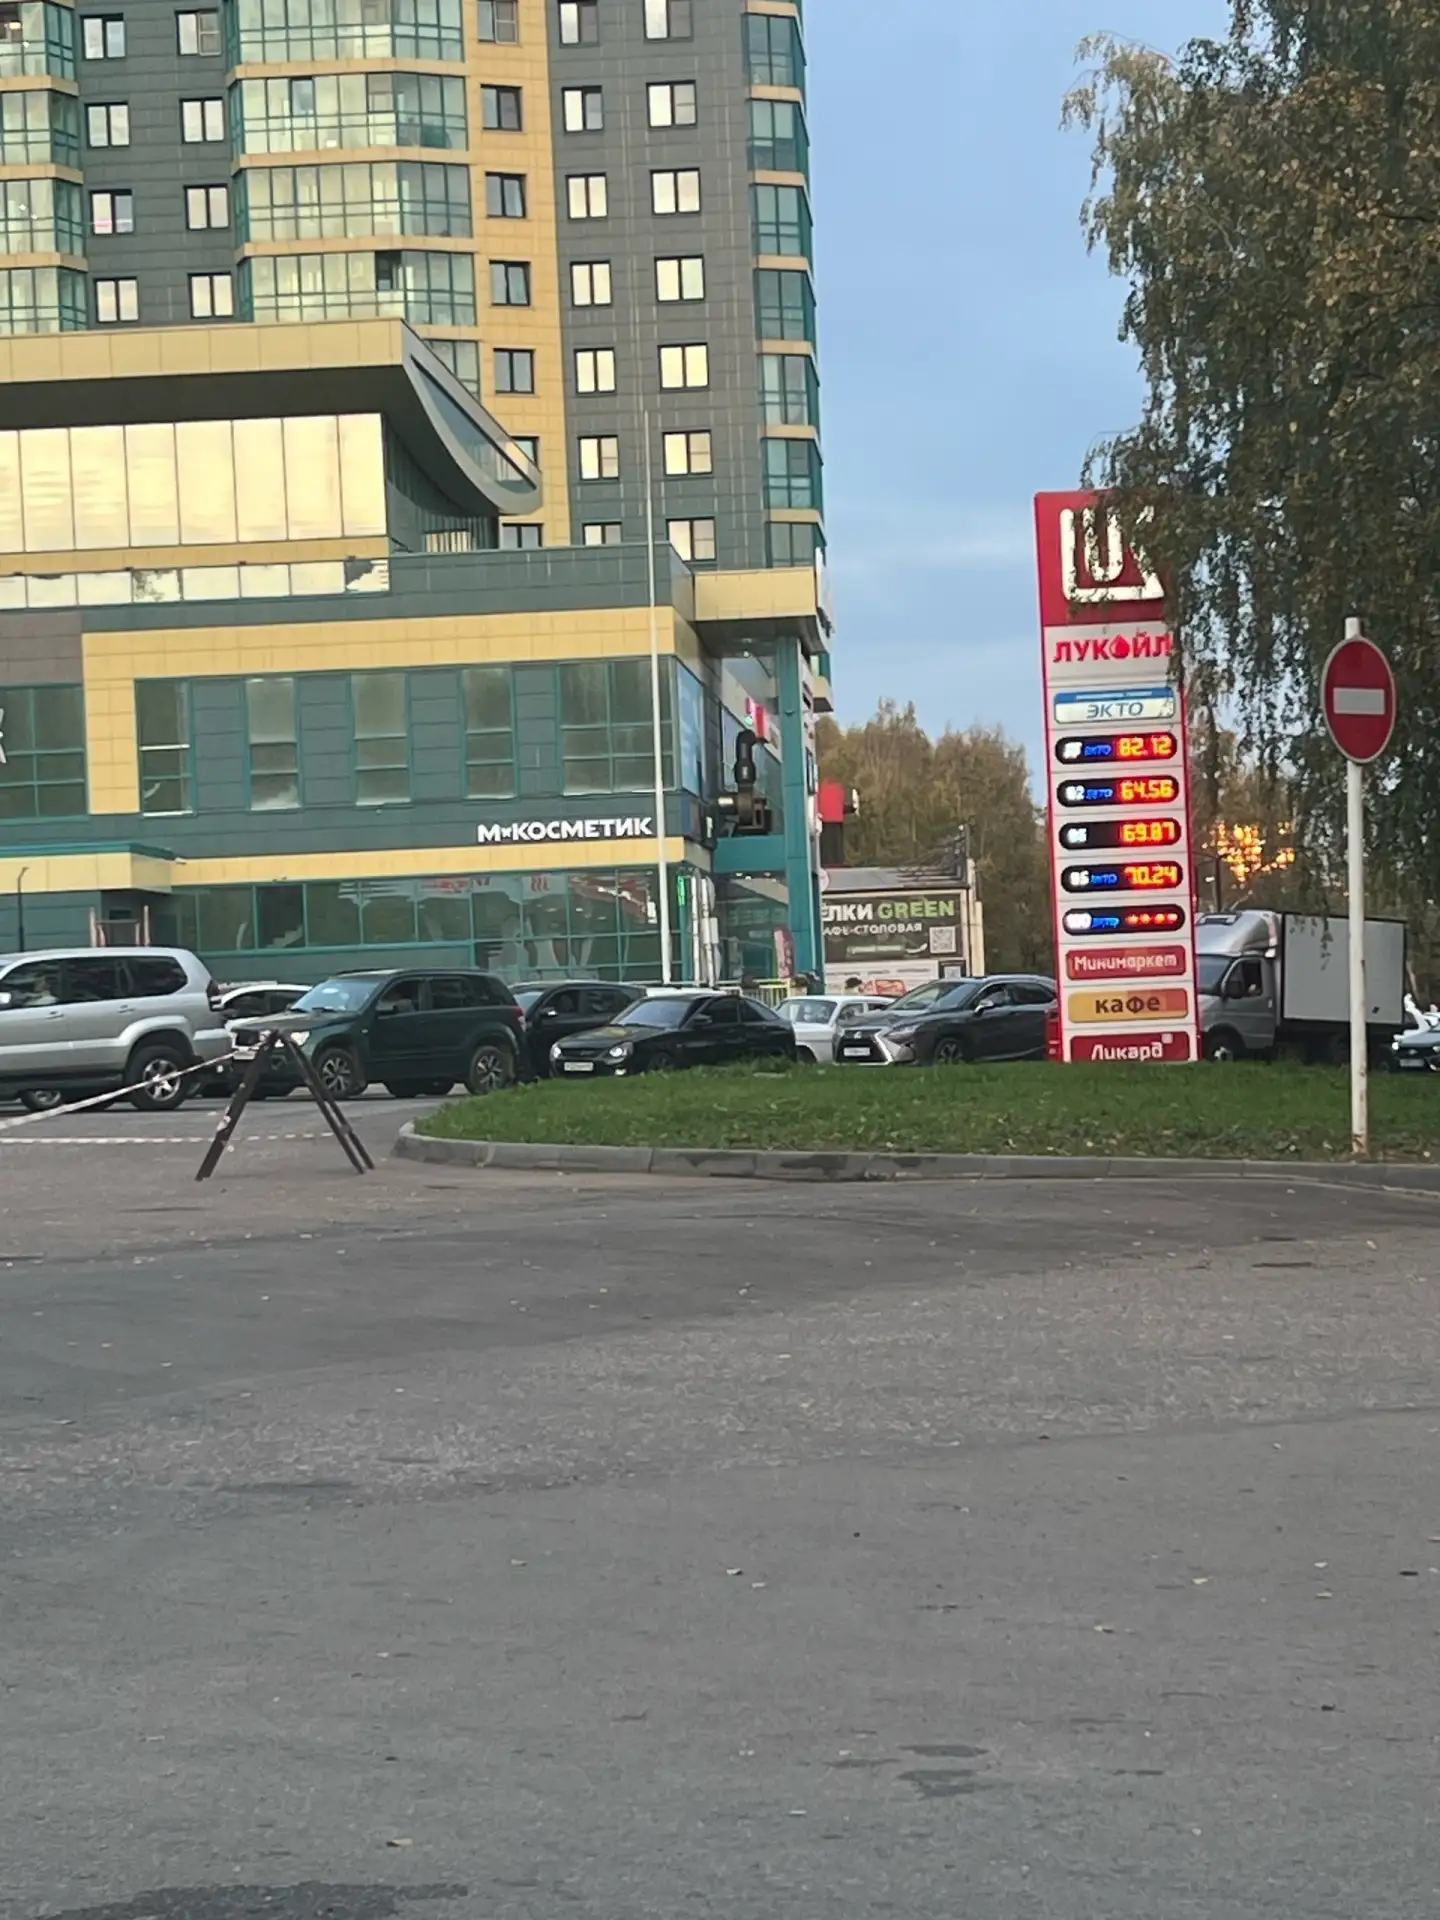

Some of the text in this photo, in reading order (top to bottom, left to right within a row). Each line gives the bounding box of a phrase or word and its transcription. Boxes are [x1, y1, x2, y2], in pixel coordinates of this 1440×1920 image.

[1053, 631, 1173, 662] ЛУКОЙЛ
[1086, 702, 1144, 719] ЭКТО
[1117, 735, 1173, 757] 82.12
[1124, 865, 1178, 886] 70.24
[877, 900, 955, 919] GREEN
[822, 922, 923, 936] АФЕ-СТОЛОВАЯ
[1073, 954, 1177, 972] Минимаркет
[1094, 996, 1161, 1014] кафе
[1090, 1041, 1164, 1061] Ликард
